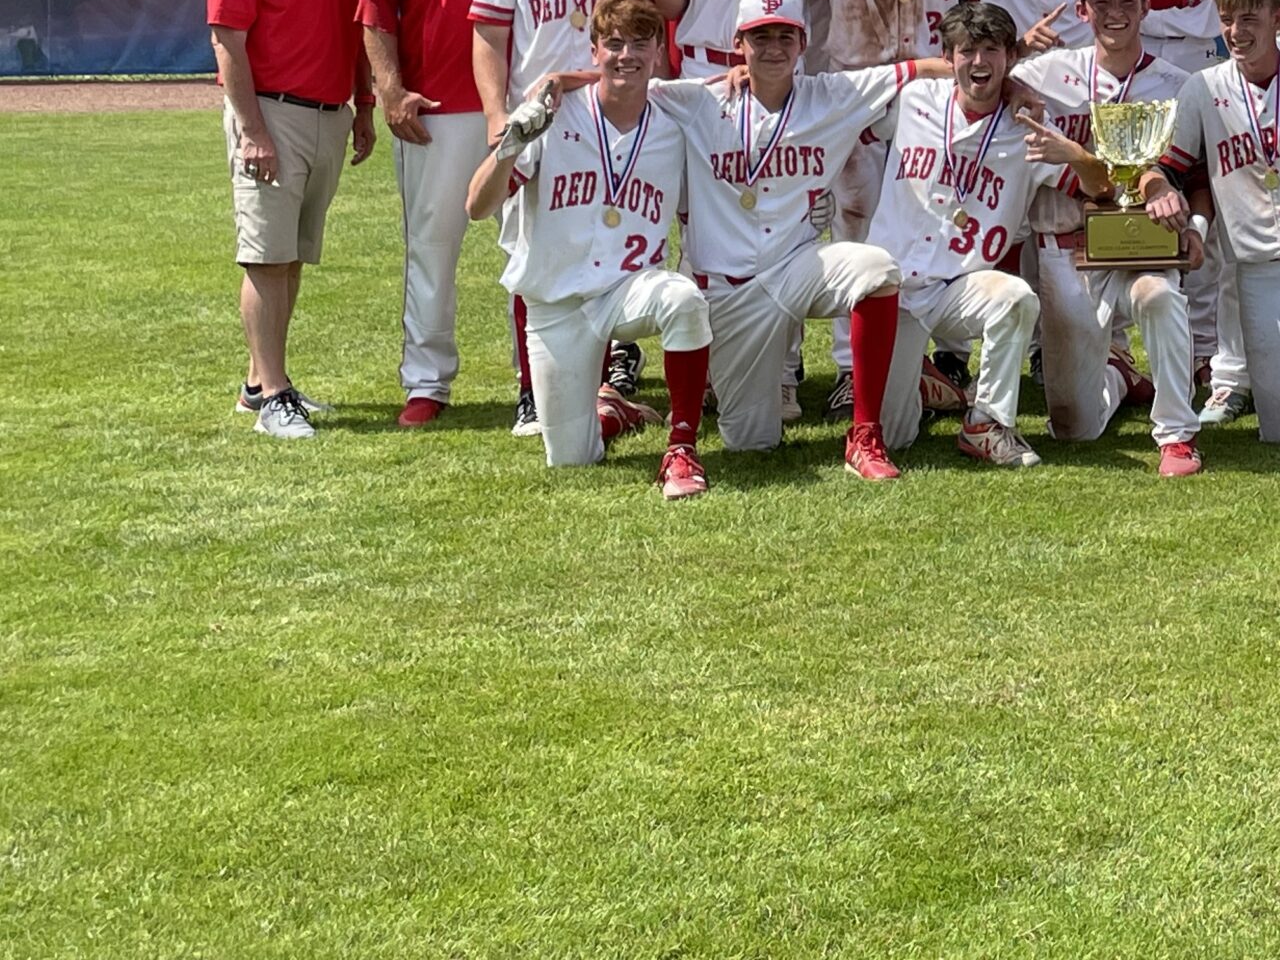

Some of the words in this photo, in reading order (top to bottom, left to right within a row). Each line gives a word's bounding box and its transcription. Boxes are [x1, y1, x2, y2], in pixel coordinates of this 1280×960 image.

[896, 147, 937, 180] RED
[1217, 132, 1258, 177] RED
[549, 171, 597, 211] RED
[948, 217, 1007, 262] 30
